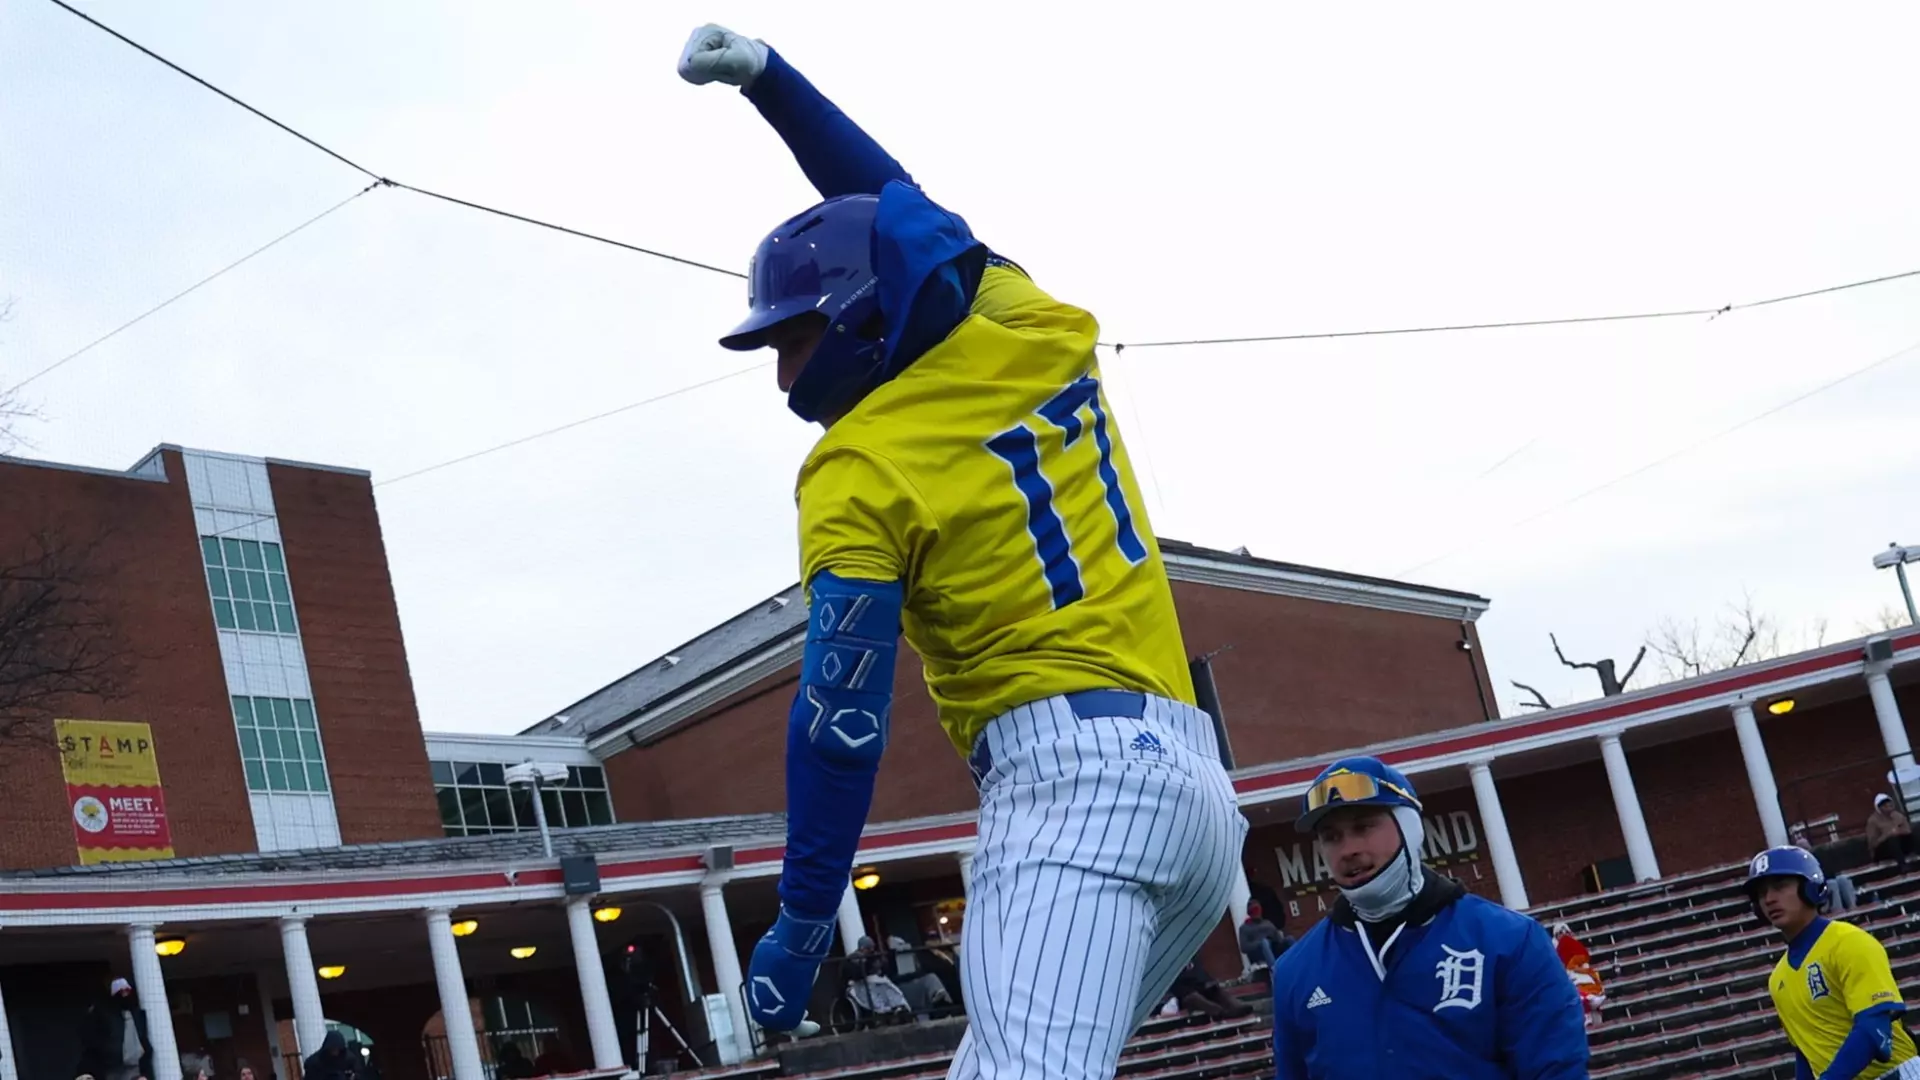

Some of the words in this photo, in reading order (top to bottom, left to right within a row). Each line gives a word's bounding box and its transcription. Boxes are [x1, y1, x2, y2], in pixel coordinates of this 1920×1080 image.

[982, 371, 1149, 611] 17
[63, 733, 149, 758] STAMP
[1129, 742, 1168, 756] adidas
[109, 797, 159, 811] MEET.
[1433, 943, 1485, 1012] D
